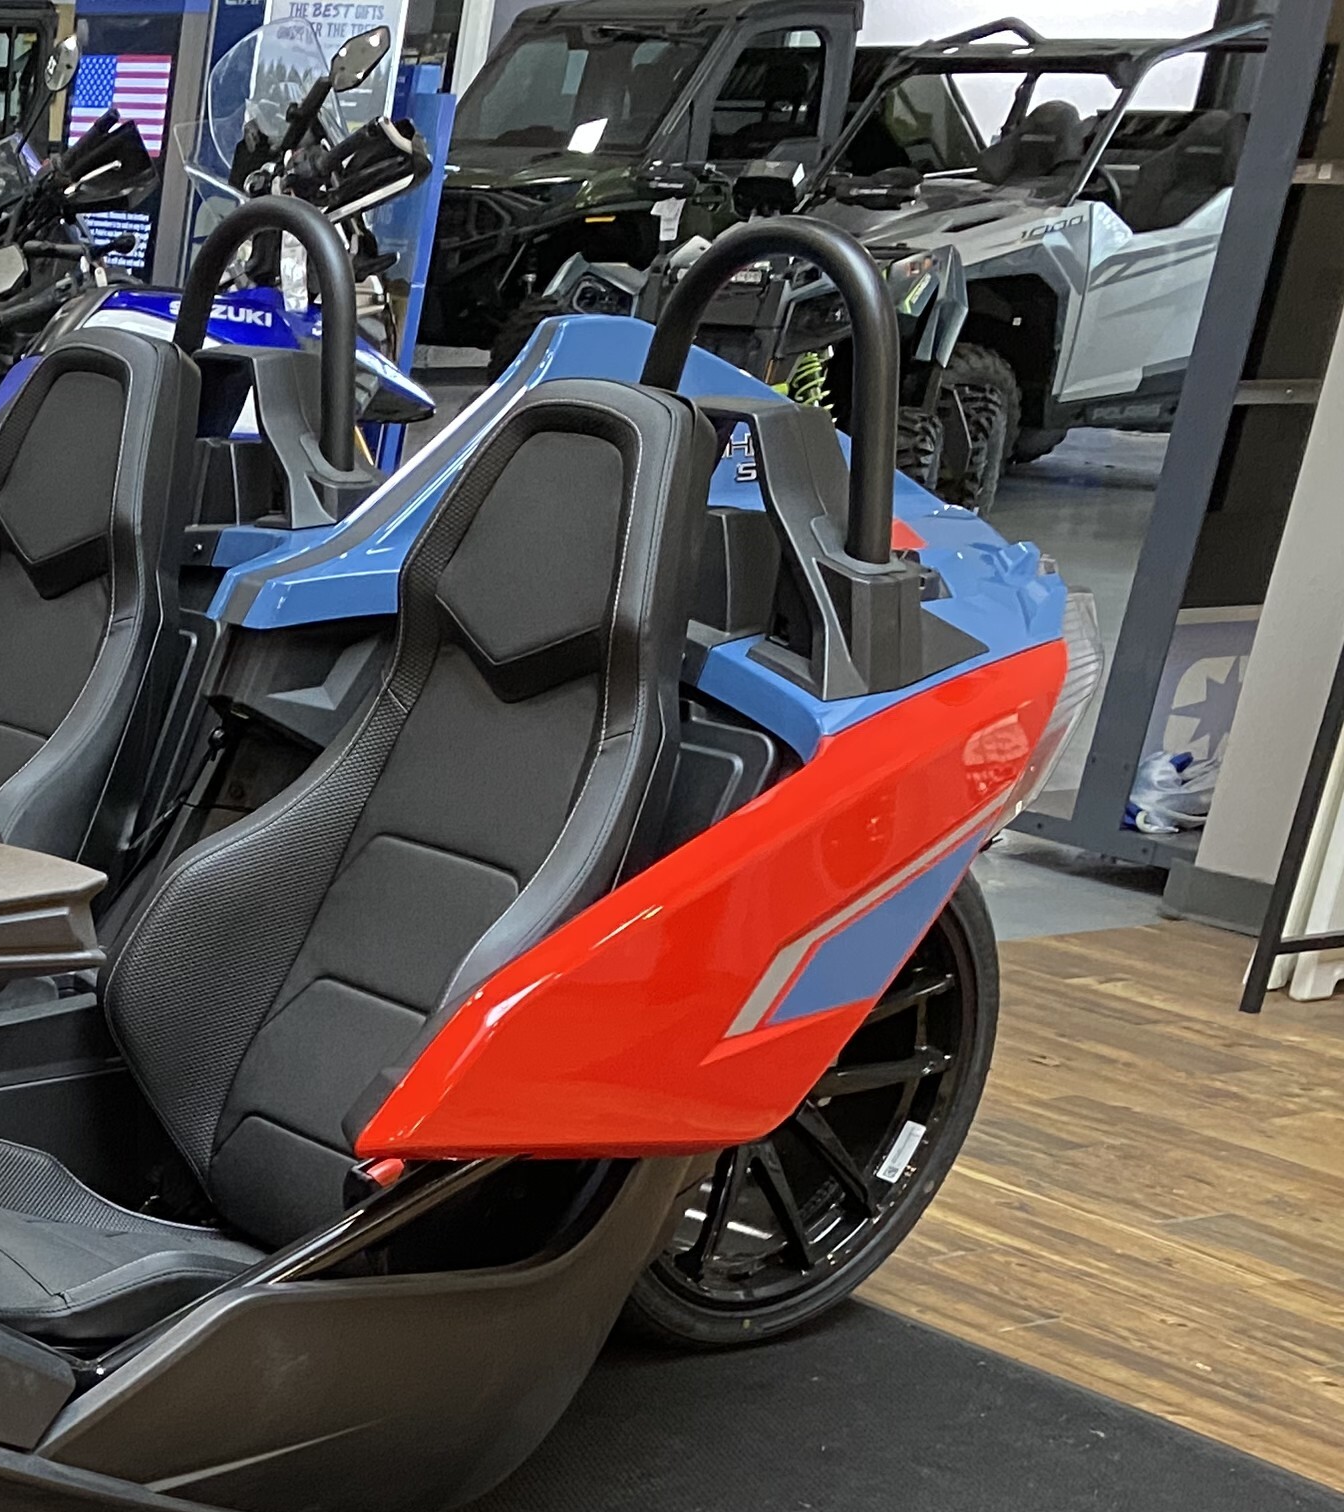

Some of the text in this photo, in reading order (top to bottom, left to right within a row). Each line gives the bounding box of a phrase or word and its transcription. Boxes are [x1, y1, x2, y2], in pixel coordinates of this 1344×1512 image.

[289, 2, 385, 20] THE BEST GIFTS
[327, 22, 346, 38] THE
[168, 300, 273, 328] SZUKI
